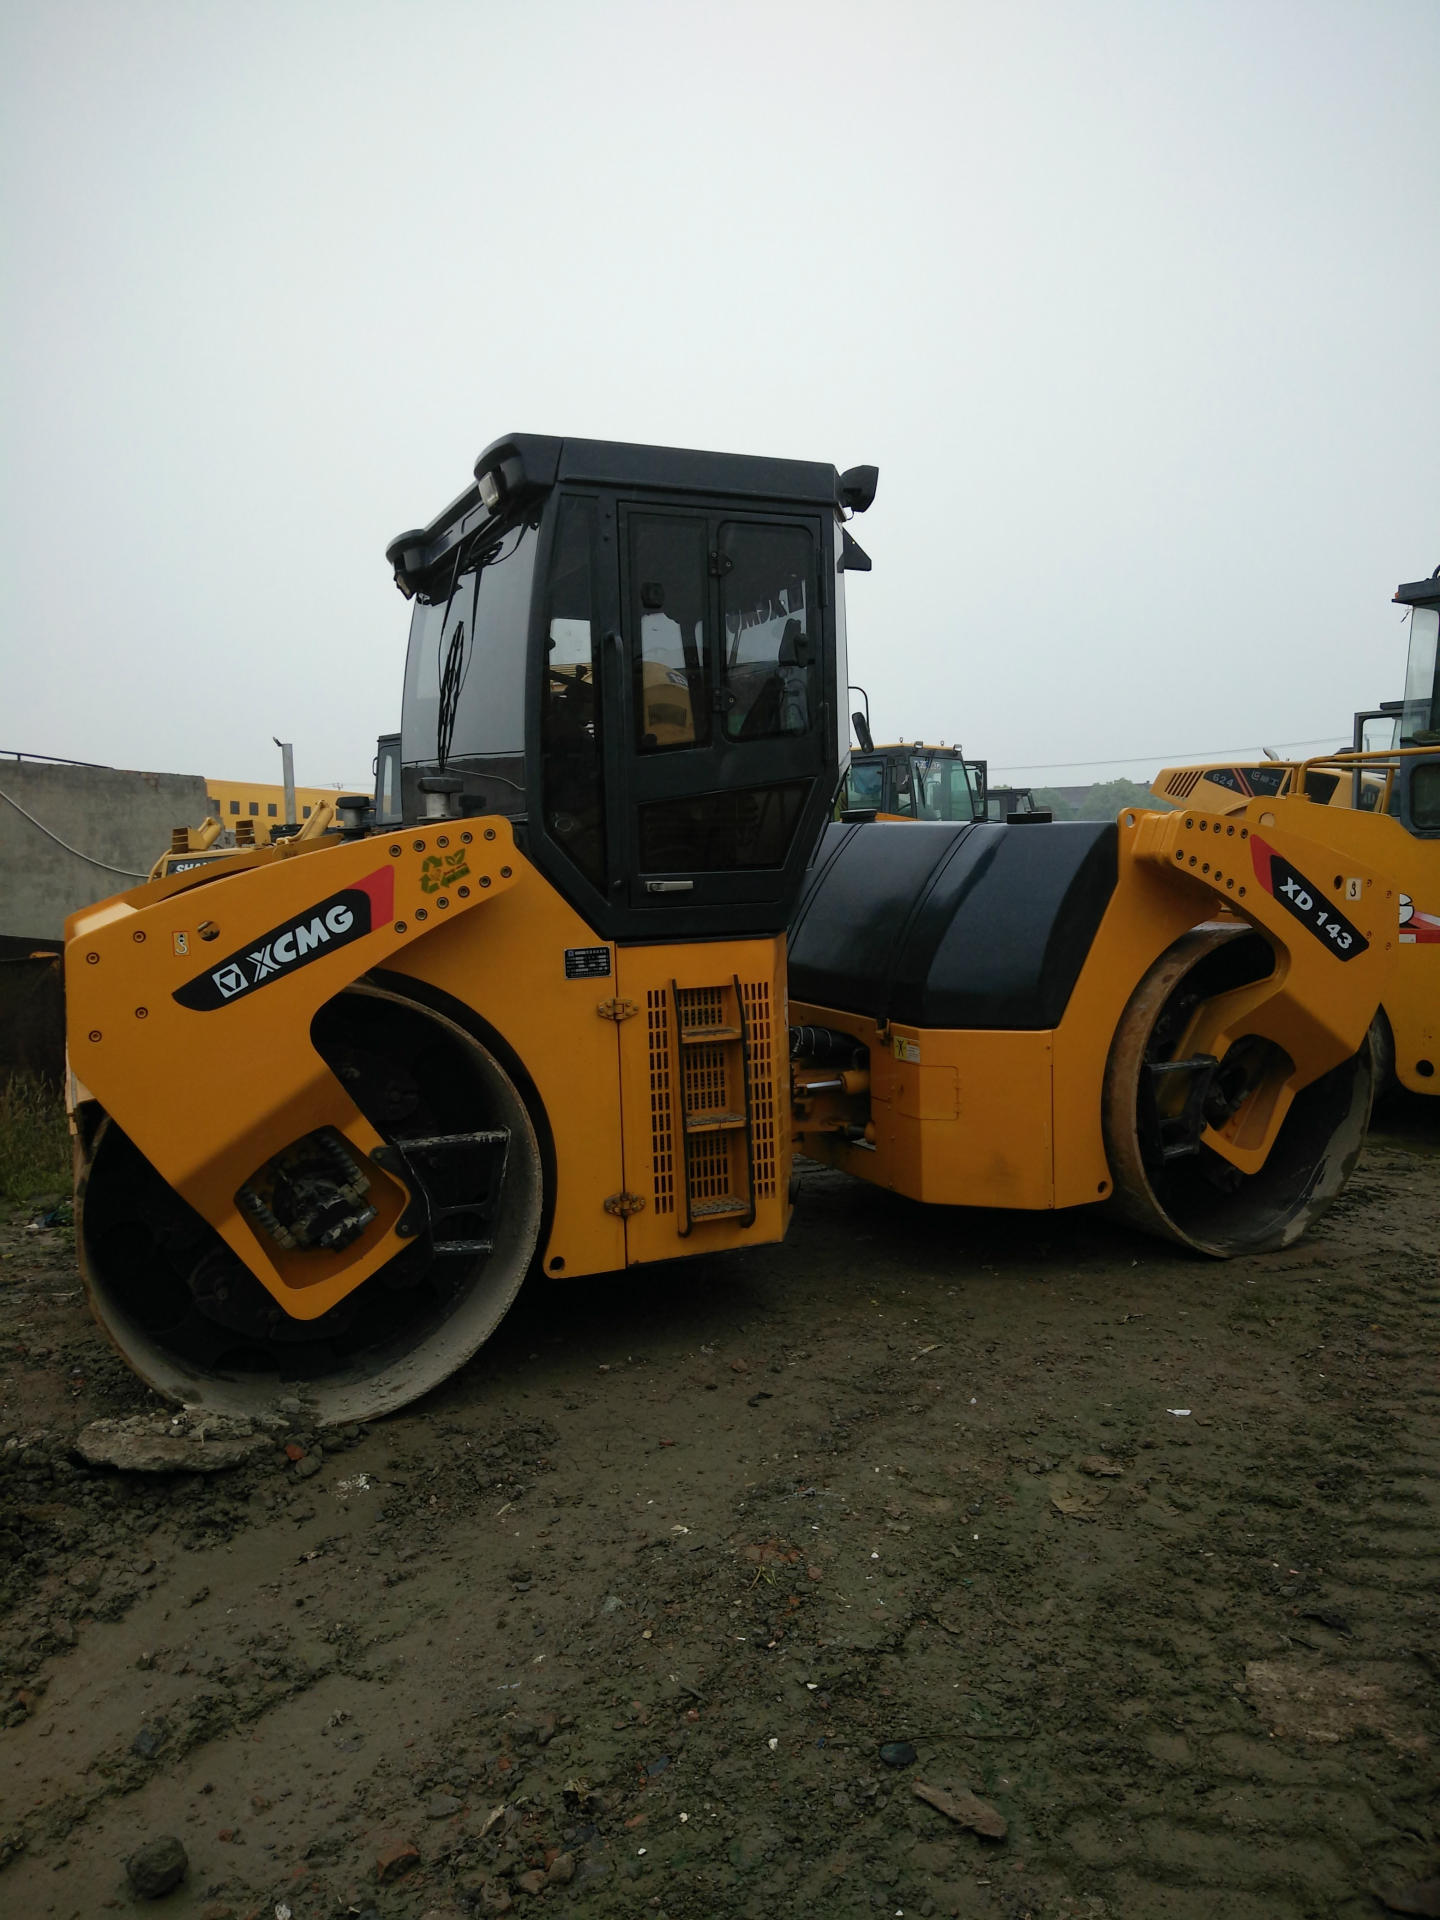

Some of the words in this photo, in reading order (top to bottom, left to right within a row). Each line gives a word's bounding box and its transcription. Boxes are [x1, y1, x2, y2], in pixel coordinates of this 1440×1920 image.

[1212, 773, 1234, 788] 624
[245, 905, 354, 983] XCMG
[1279, 876, 1314, 911] XD
[1316, 911, 1353, 949] 143
